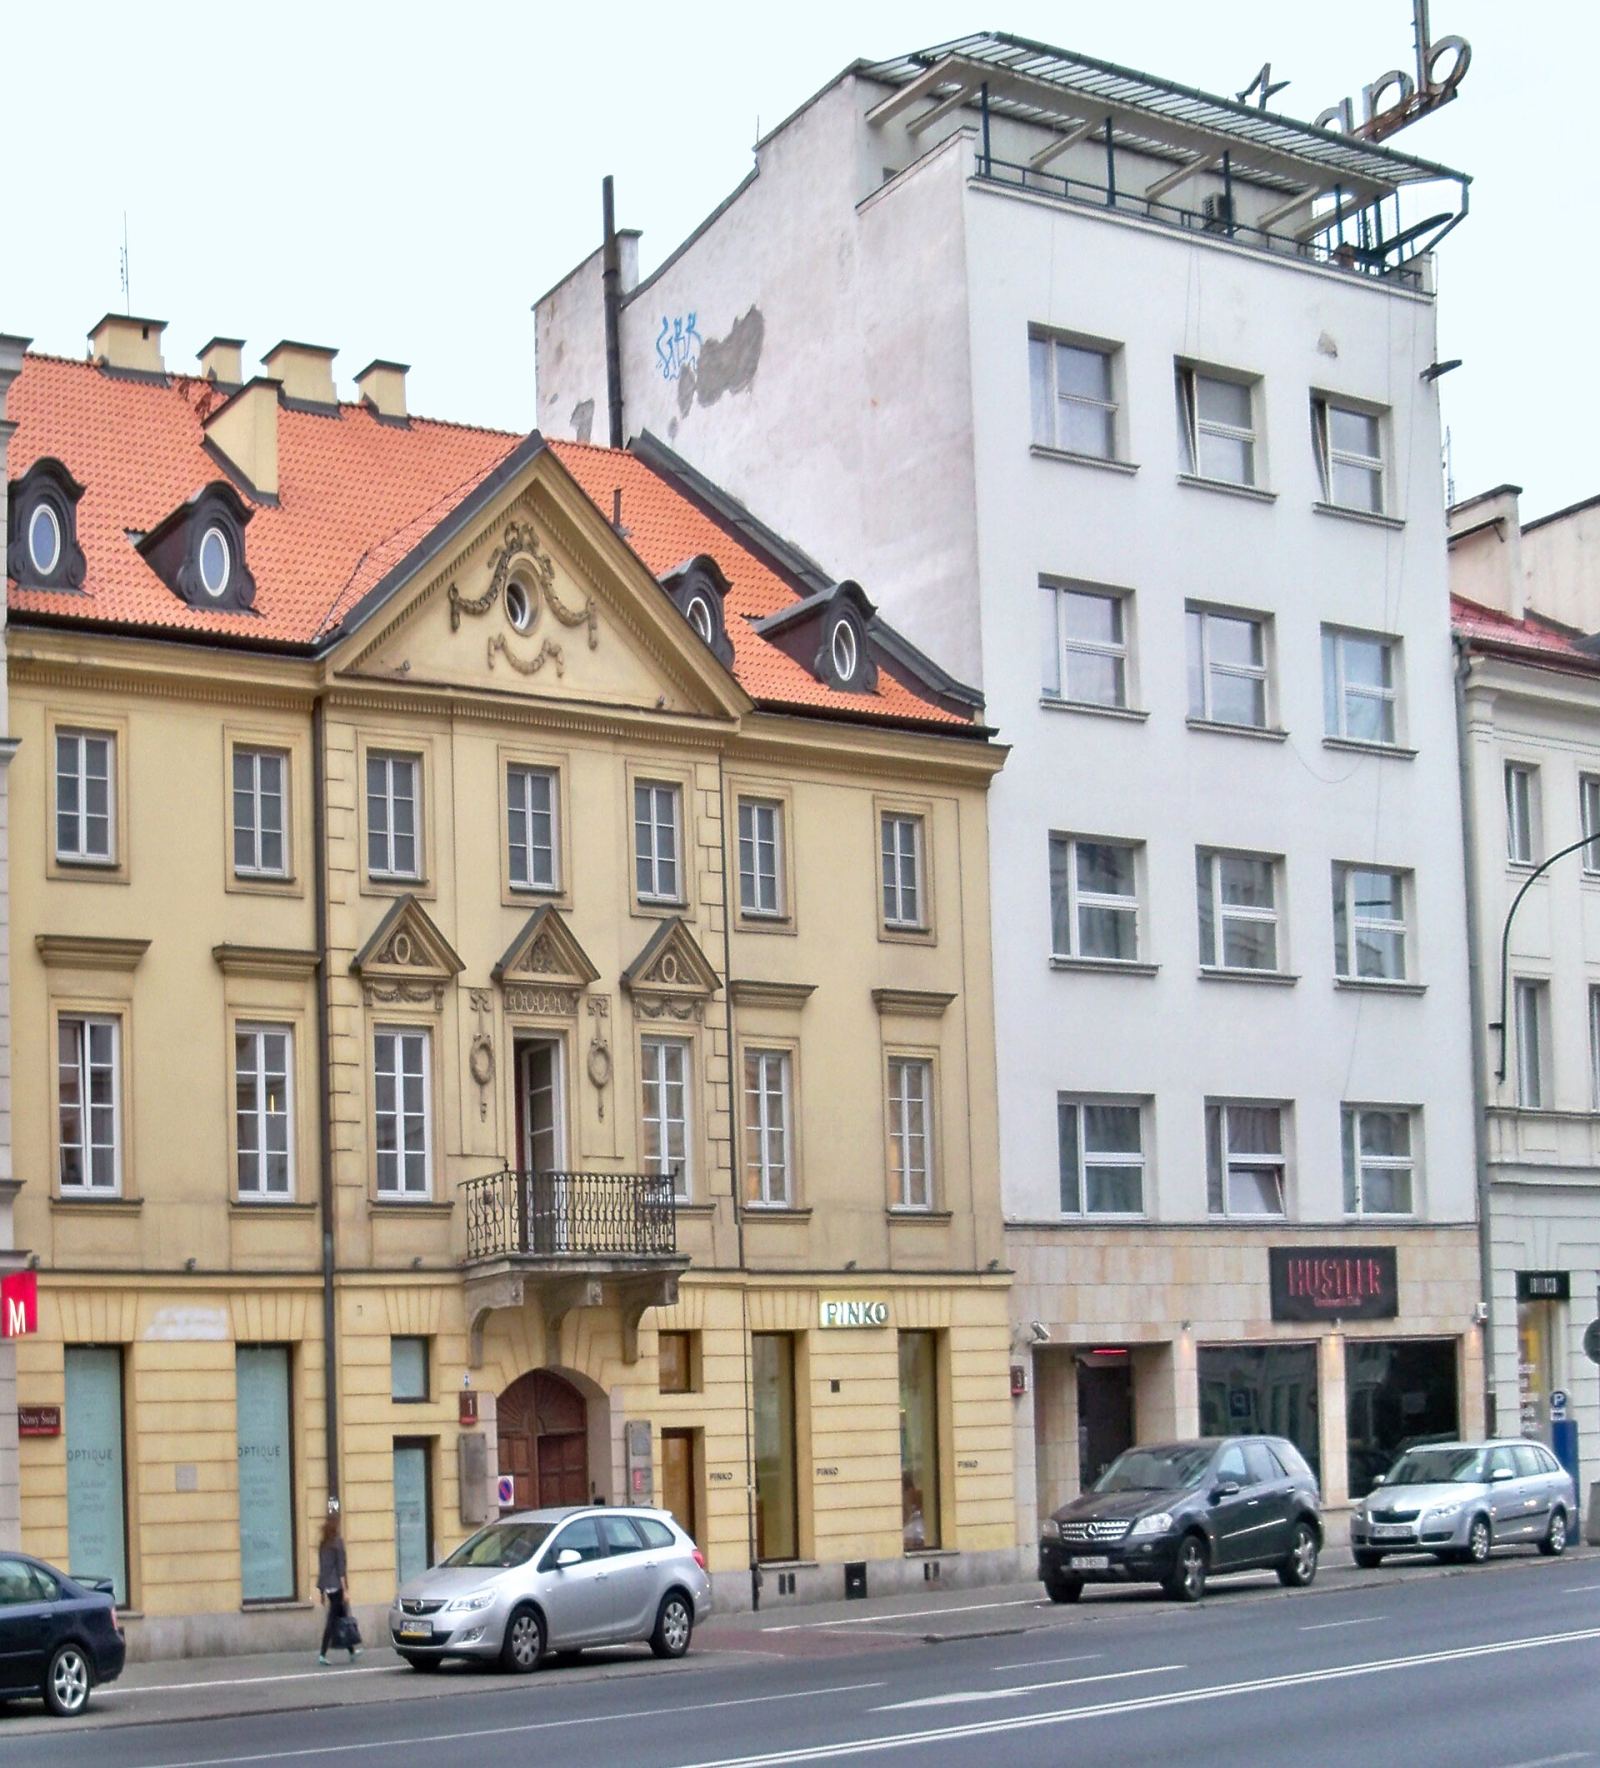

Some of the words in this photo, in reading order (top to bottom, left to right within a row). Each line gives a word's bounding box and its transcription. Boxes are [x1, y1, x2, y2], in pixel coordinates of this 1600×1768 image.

[8, 1297, 26, 1337] M
[827, 1302, 889, 1324] PINKO
[467, 1398, 474, 1415] 1
[1554, 1393, 1564, 1405] P
[20, 1414, 40, 1429] Nowy
[66, 1448, 113, 1466] OPTIQUE
[957, 1460, 978, 1468] PINKO
[709, 1472, 733, 1481] PINKO
[816, 1467, 839, 1476] PINKO
